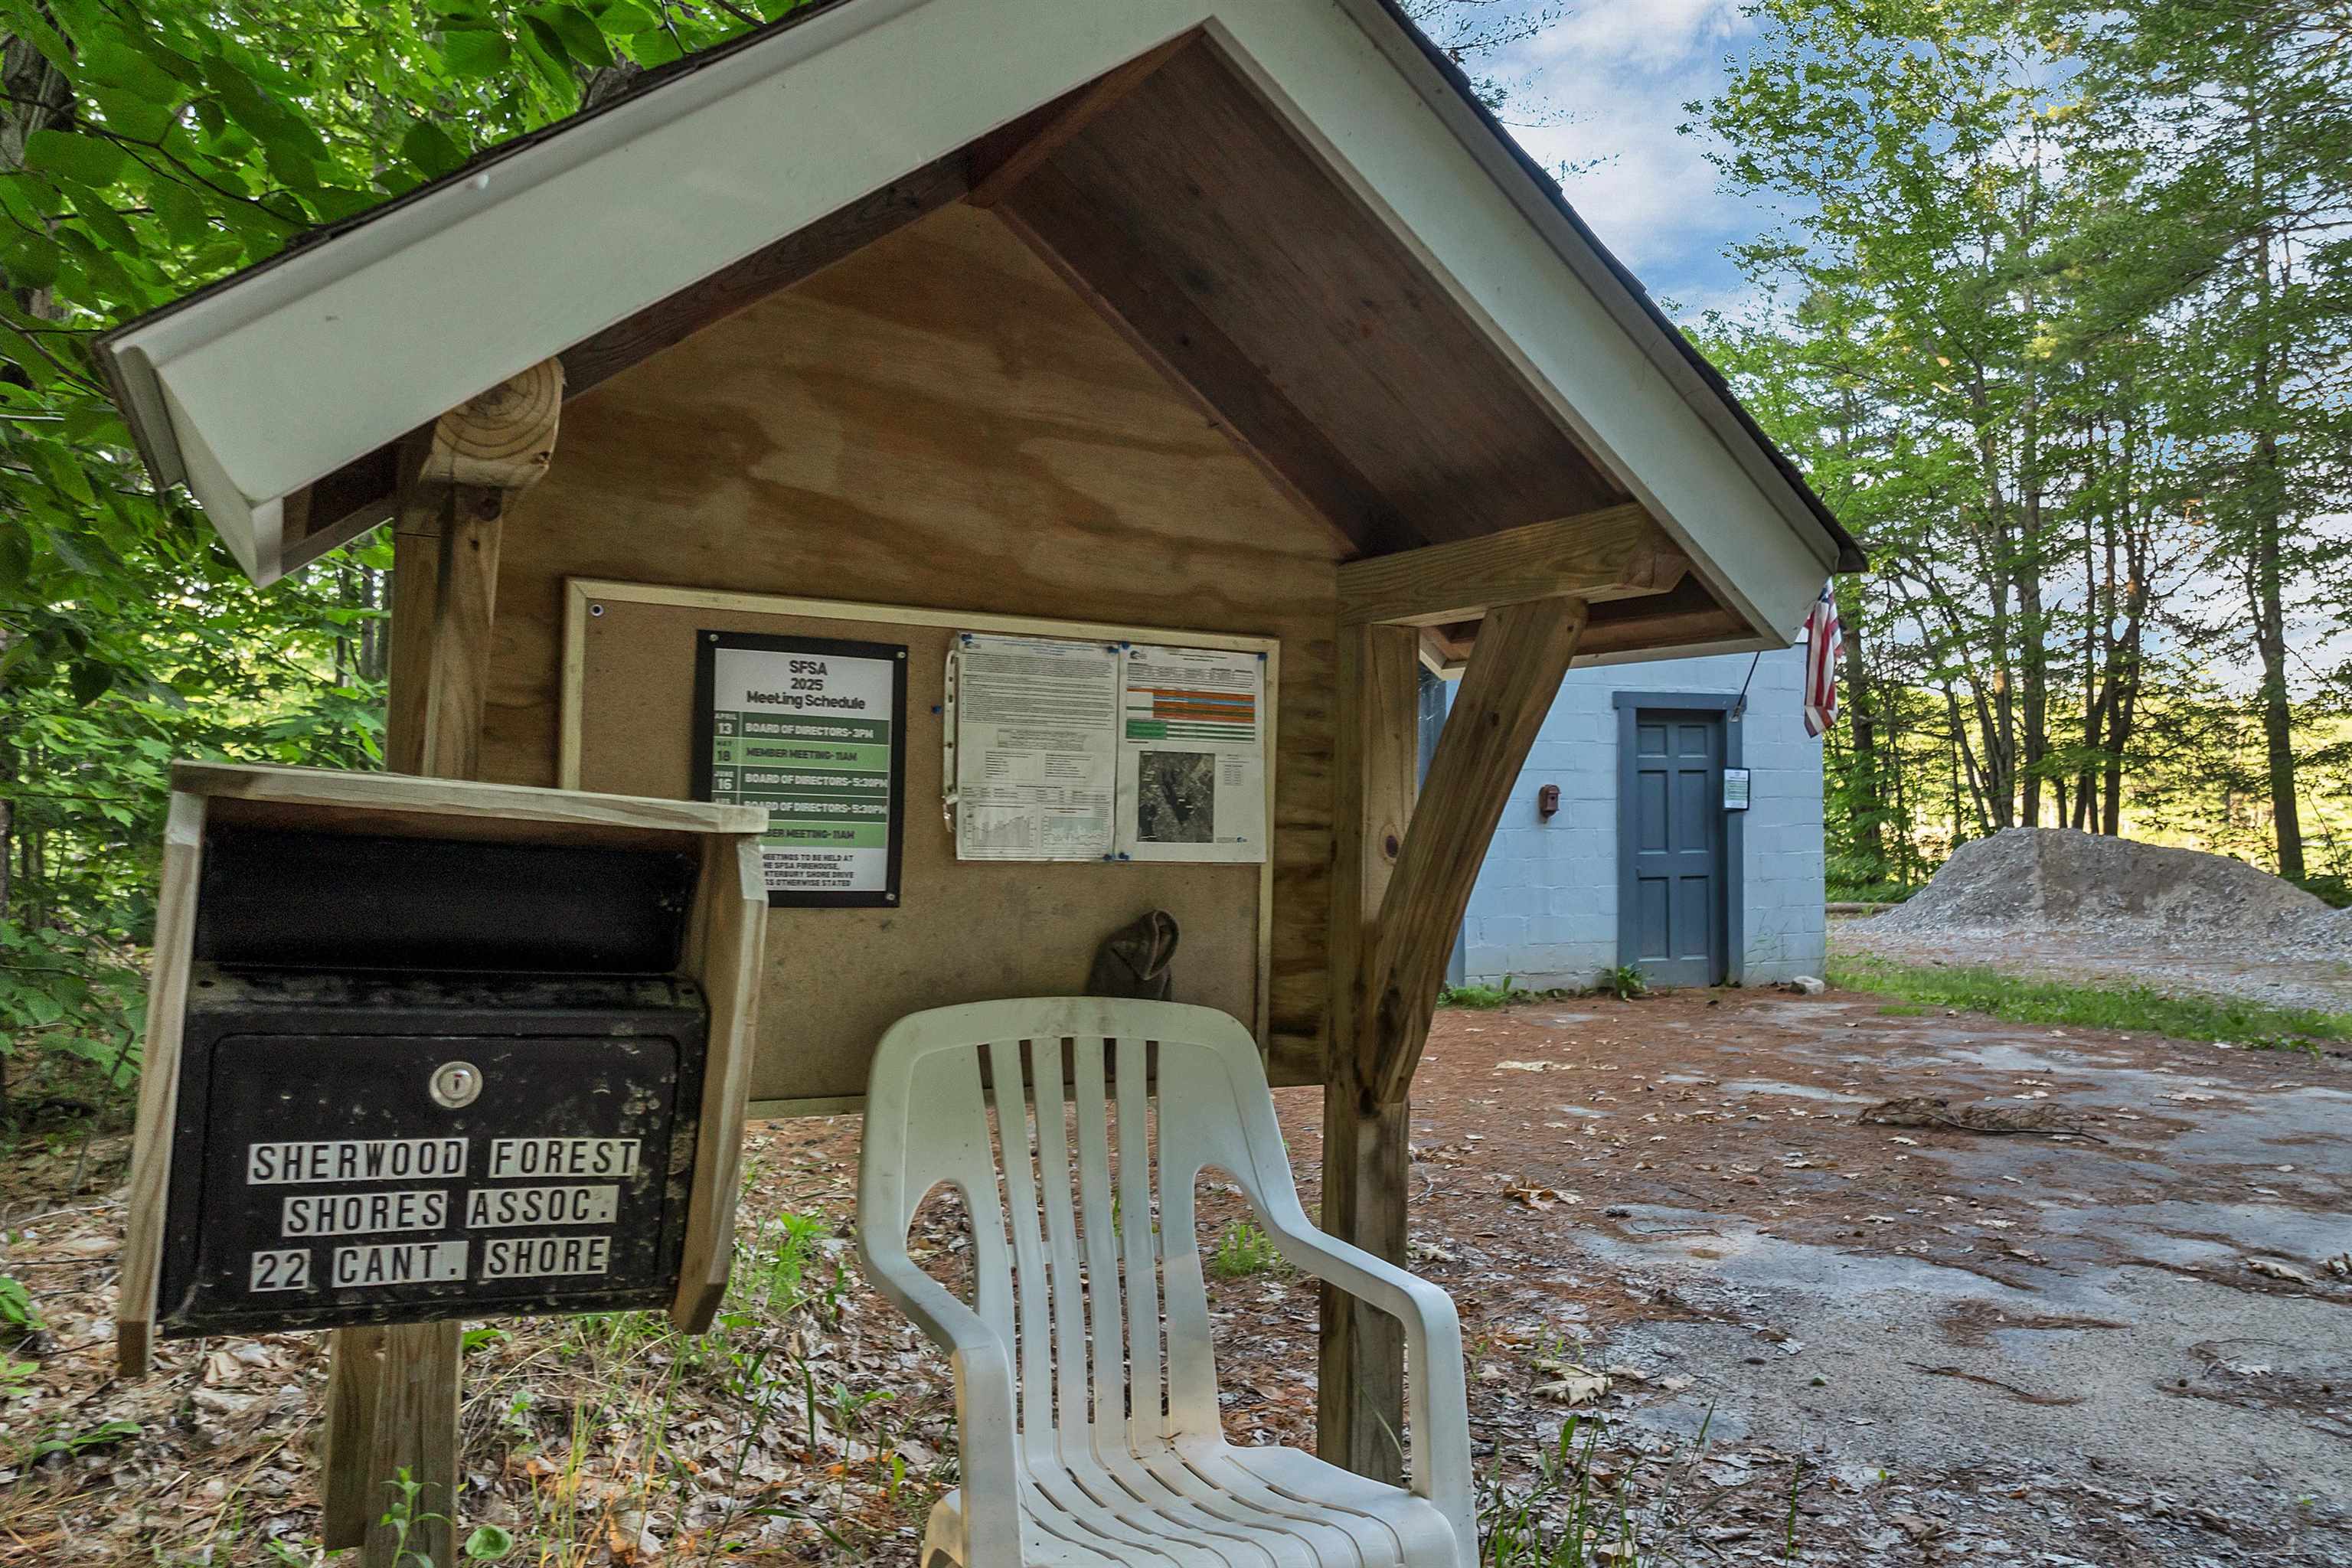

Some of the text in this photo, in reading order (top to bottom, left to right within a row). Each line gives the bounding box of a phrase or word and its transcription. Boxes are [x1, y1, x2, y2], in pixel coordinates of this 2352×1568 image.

[789, 660, 828, 675] SFSA
[791, 678, 824, 691] 2025
[746, 691, 865, 709] Meeting Schedule
[718, 723, 733, 735] 13
[745, 723, 780, 733] BOARD
[781, 724, 795, 734] OF
[852, 728, 874, 739] 3PM
[717, 750, 730, 761] 18
[746, 747, 786, 758] MEMBER
[717, 778, 732, 790] 16
[745, 773, 779, 784] BOARD
[781, 774, 794, 784] OF
[852, 777, 887, 788] 5:30PM
[779, 802, 793, 811] OF
[253, 1140, 638, 1180] SHERWOOD FOREST
[286, 1188, 608, 1233] SHORES ASSOC.
[256, 1239, 606, 1289] 22 CANT. SHORE
